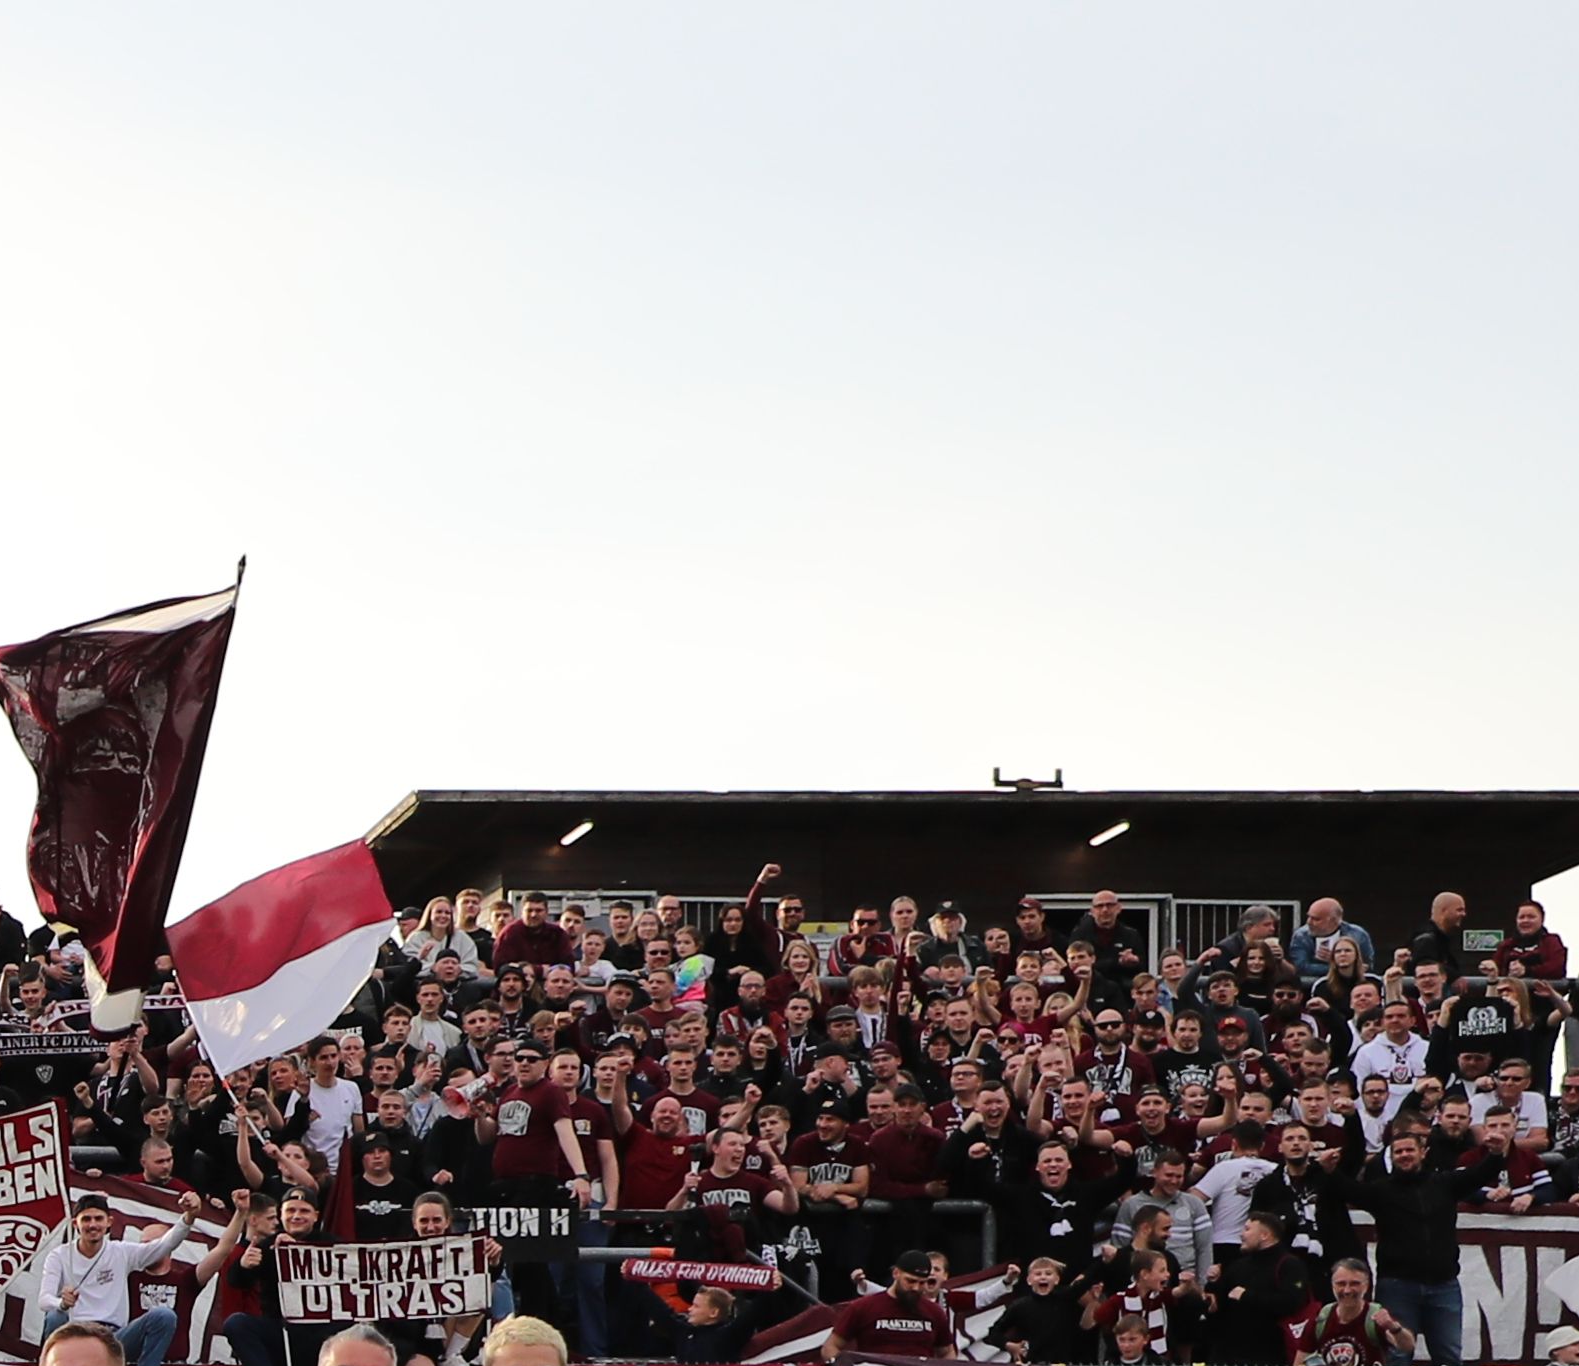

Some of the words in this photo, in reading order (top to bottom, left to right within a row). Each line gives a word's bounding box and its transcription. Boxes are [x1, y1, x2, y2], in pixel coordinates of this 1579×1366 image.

[631, 1259, 675, 1280] ALLES
[708, 1265, 772, 1287] DYNAMO
[306, 1280, 466, 1321] ULTRAS
